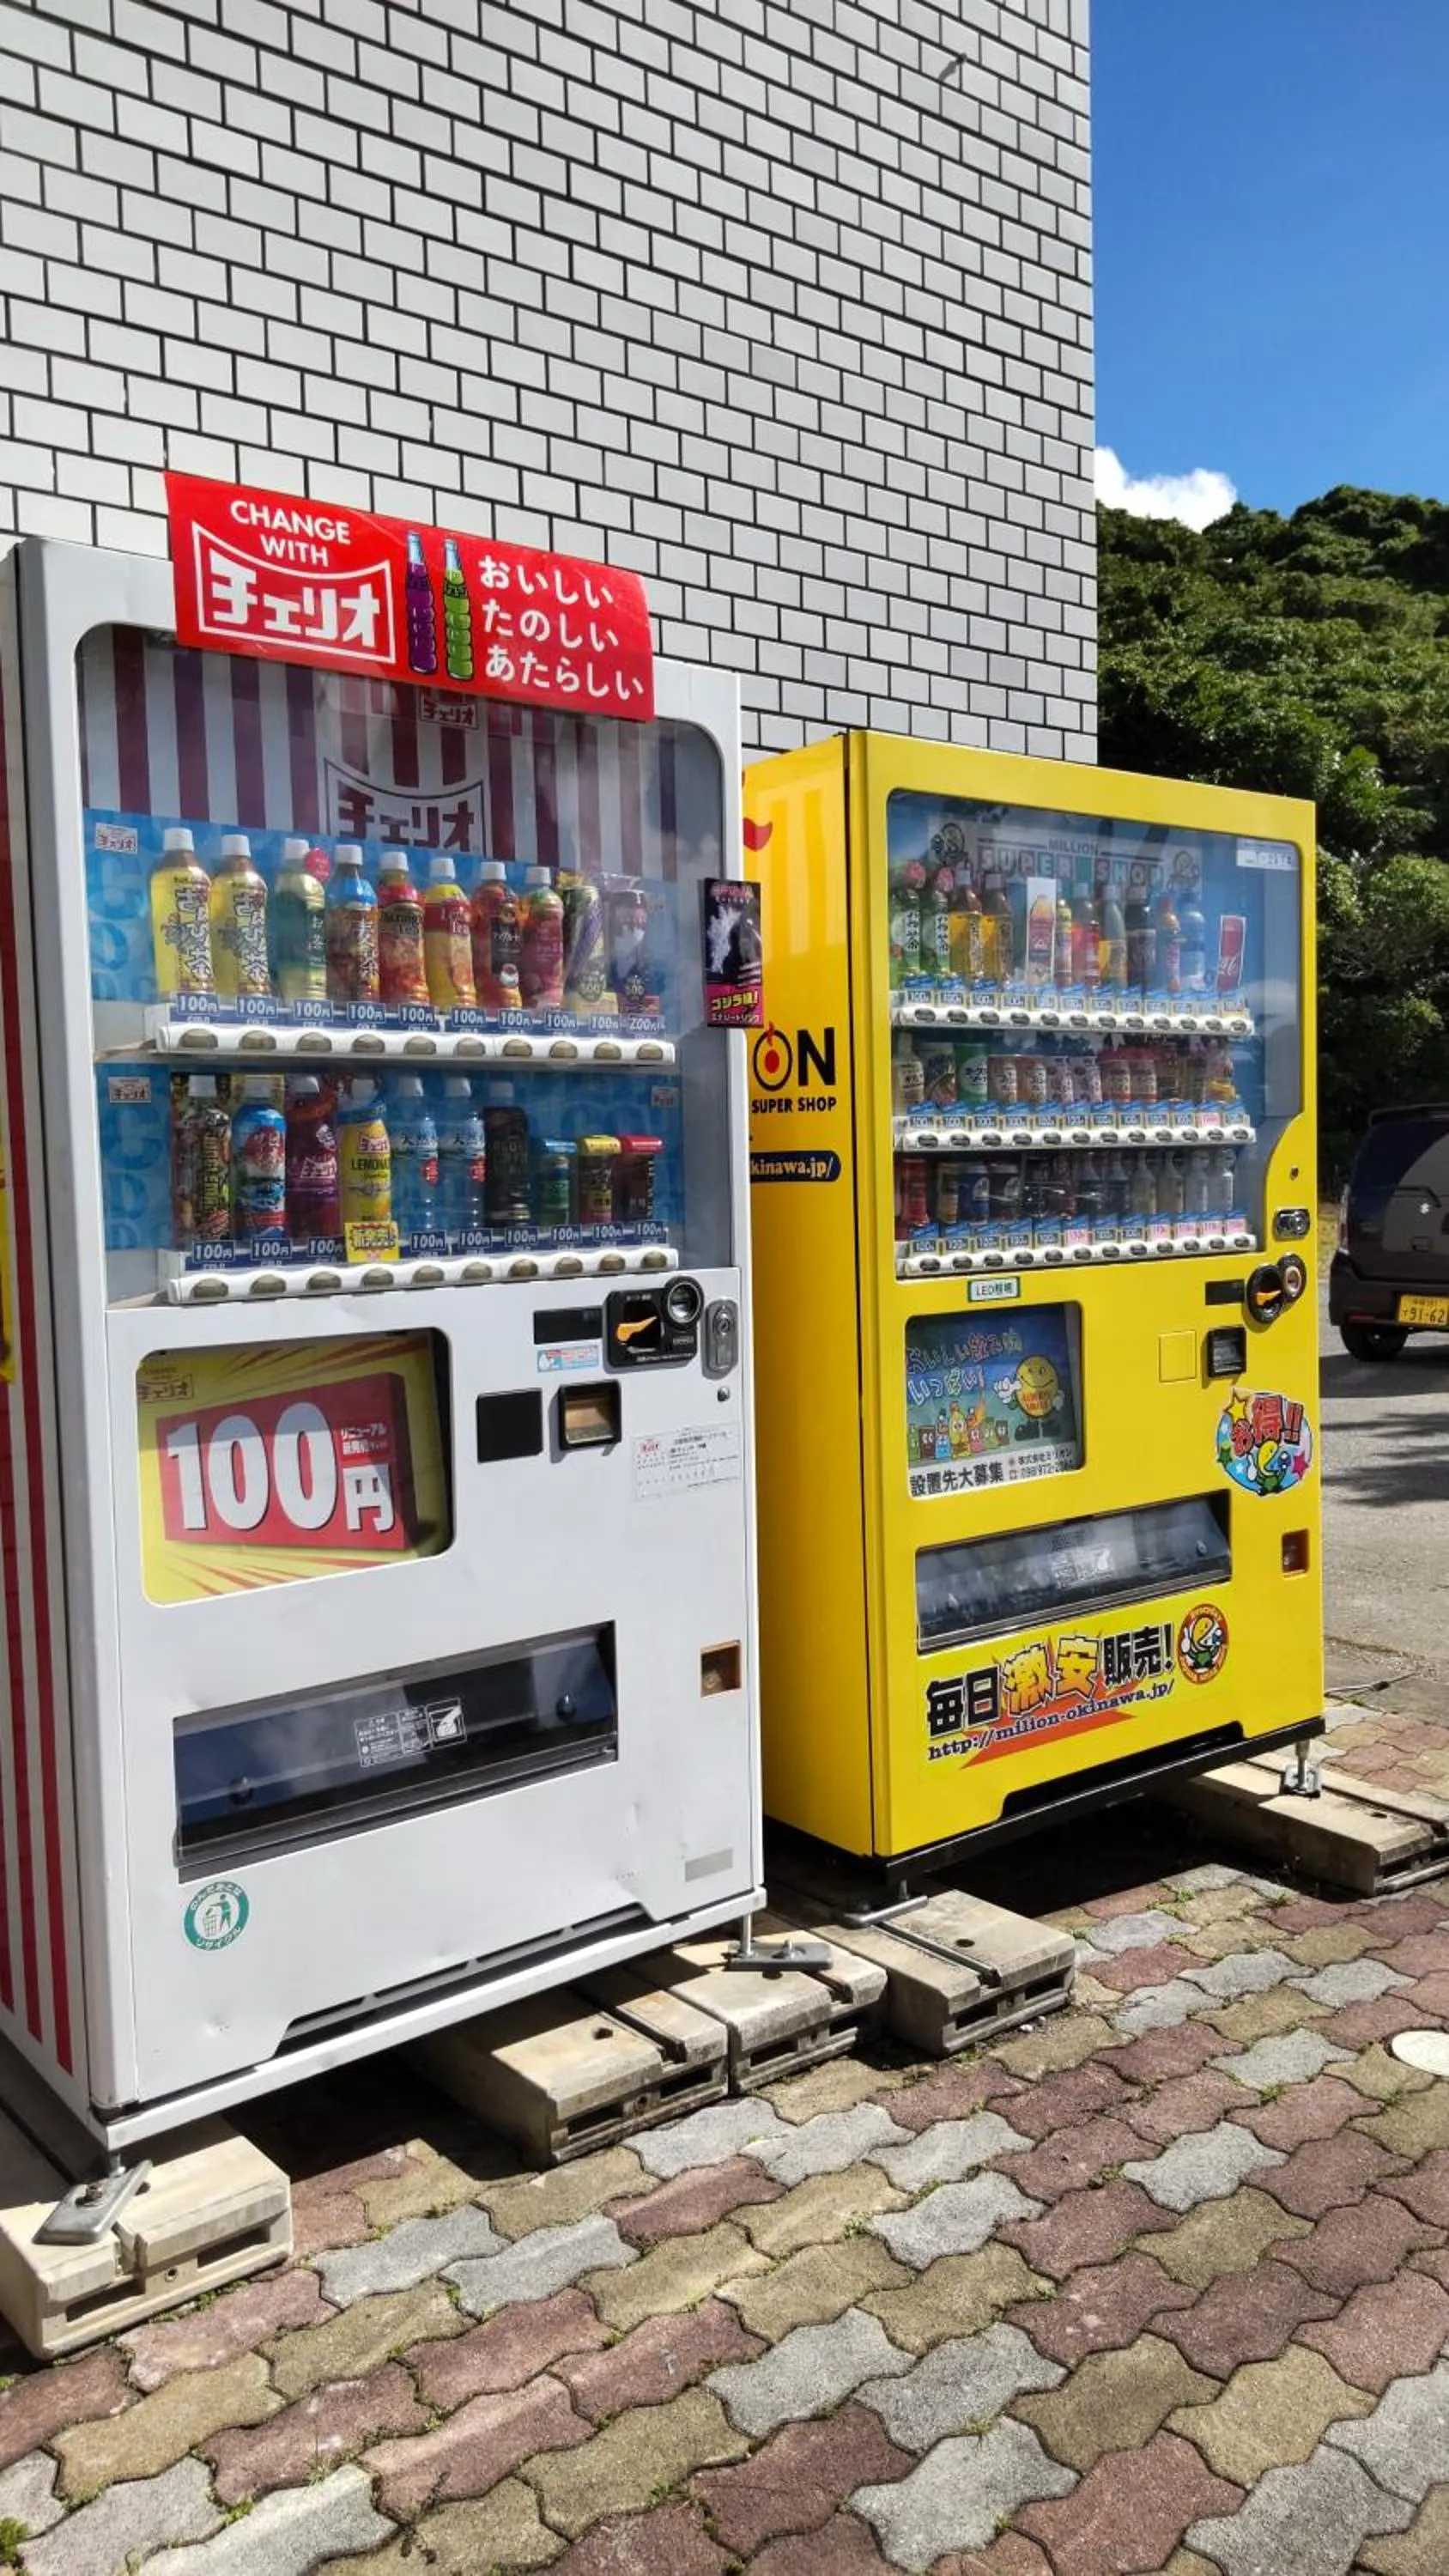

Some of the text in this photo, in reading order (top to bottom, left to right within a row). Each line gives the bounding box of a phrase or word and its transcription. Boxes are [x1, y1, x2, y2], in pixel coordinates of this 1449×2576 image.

[229, 500, 351, 546] CHANGE
[259, 535, 329, 568] WITH
[209, 544, 380, 648] チェリオ
[477, 555, 614, 610] おいしい
[482, 598, 619, 653] たのしい
[484, 644, 645, 702] あたらしい
[337, 779, 475, 853] チェリオ
[751, 1096, 837, 1115] SUPER SHOP
[910, 1461, 1004, 1498] 設置先大募集
[926, 1622, 1174, 1738] 毎日激安販売!
